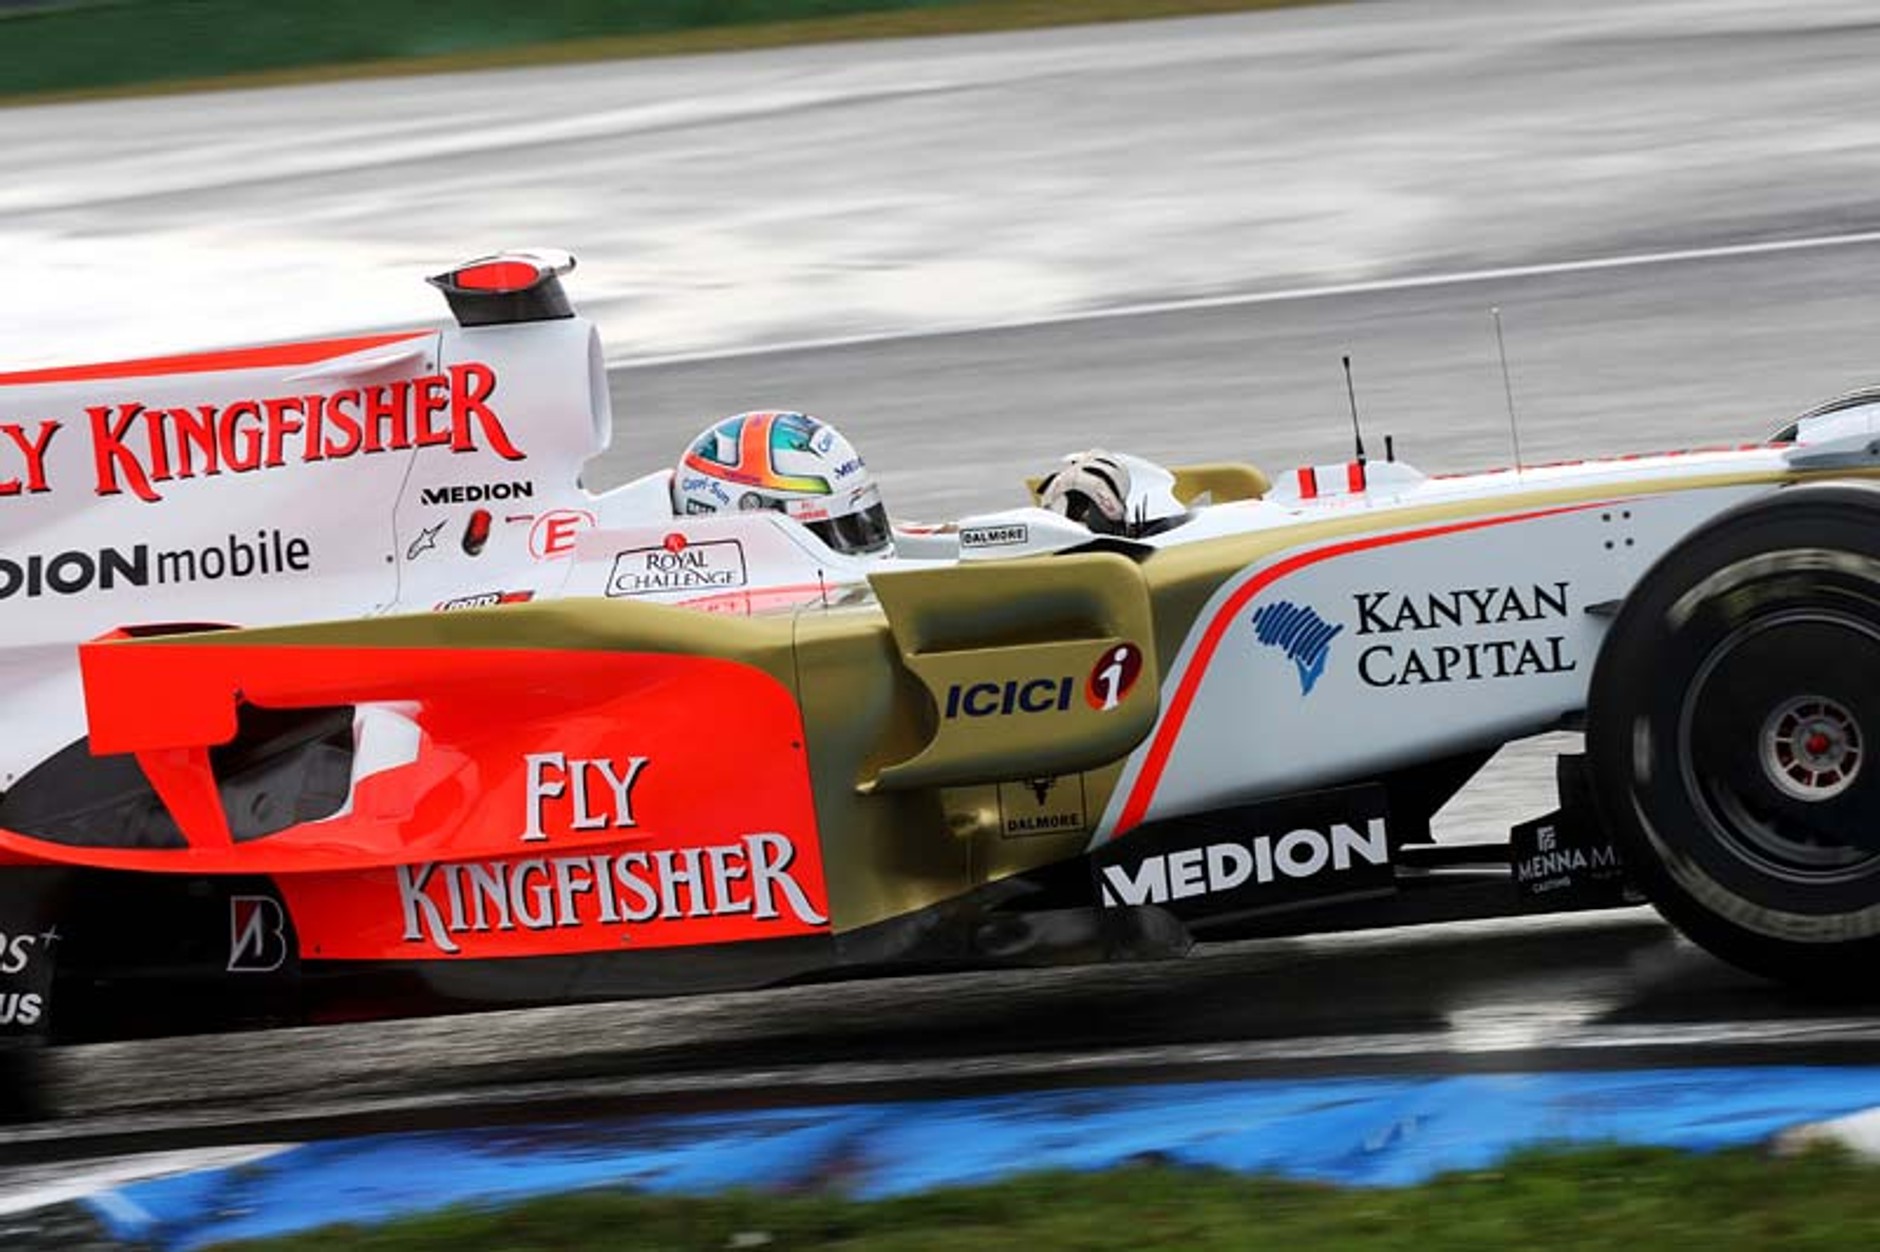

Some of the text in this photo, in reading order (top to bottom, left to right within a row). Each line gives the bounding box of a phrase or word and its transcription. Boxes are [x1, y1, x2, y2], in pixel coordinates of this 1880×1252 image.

[84, 362, 527, 503] KINGFISHER
[421, 481, 534, 505] MEDION
[544, 516, 580, 554] E
[964, 528, 1024, 545] DALMORE
[645, 549, 709, 570] ROYAL
[616, 569, 736, 592] CHALLENGE
[1353, 582, 1570, 635] KANYAN
[1358, 636, 1577, 688] CAPITAL
[945, 676, 1074, 719] ICICI
[519, 750, 651, 842] FLY
[1007, 812, 1081, 832] DALMORE
[1102, 817, 1390, 909] MEDION
[1518, 847, 1588, 883] MENNA
[396, 830, 829, 953] KINGFISHER
